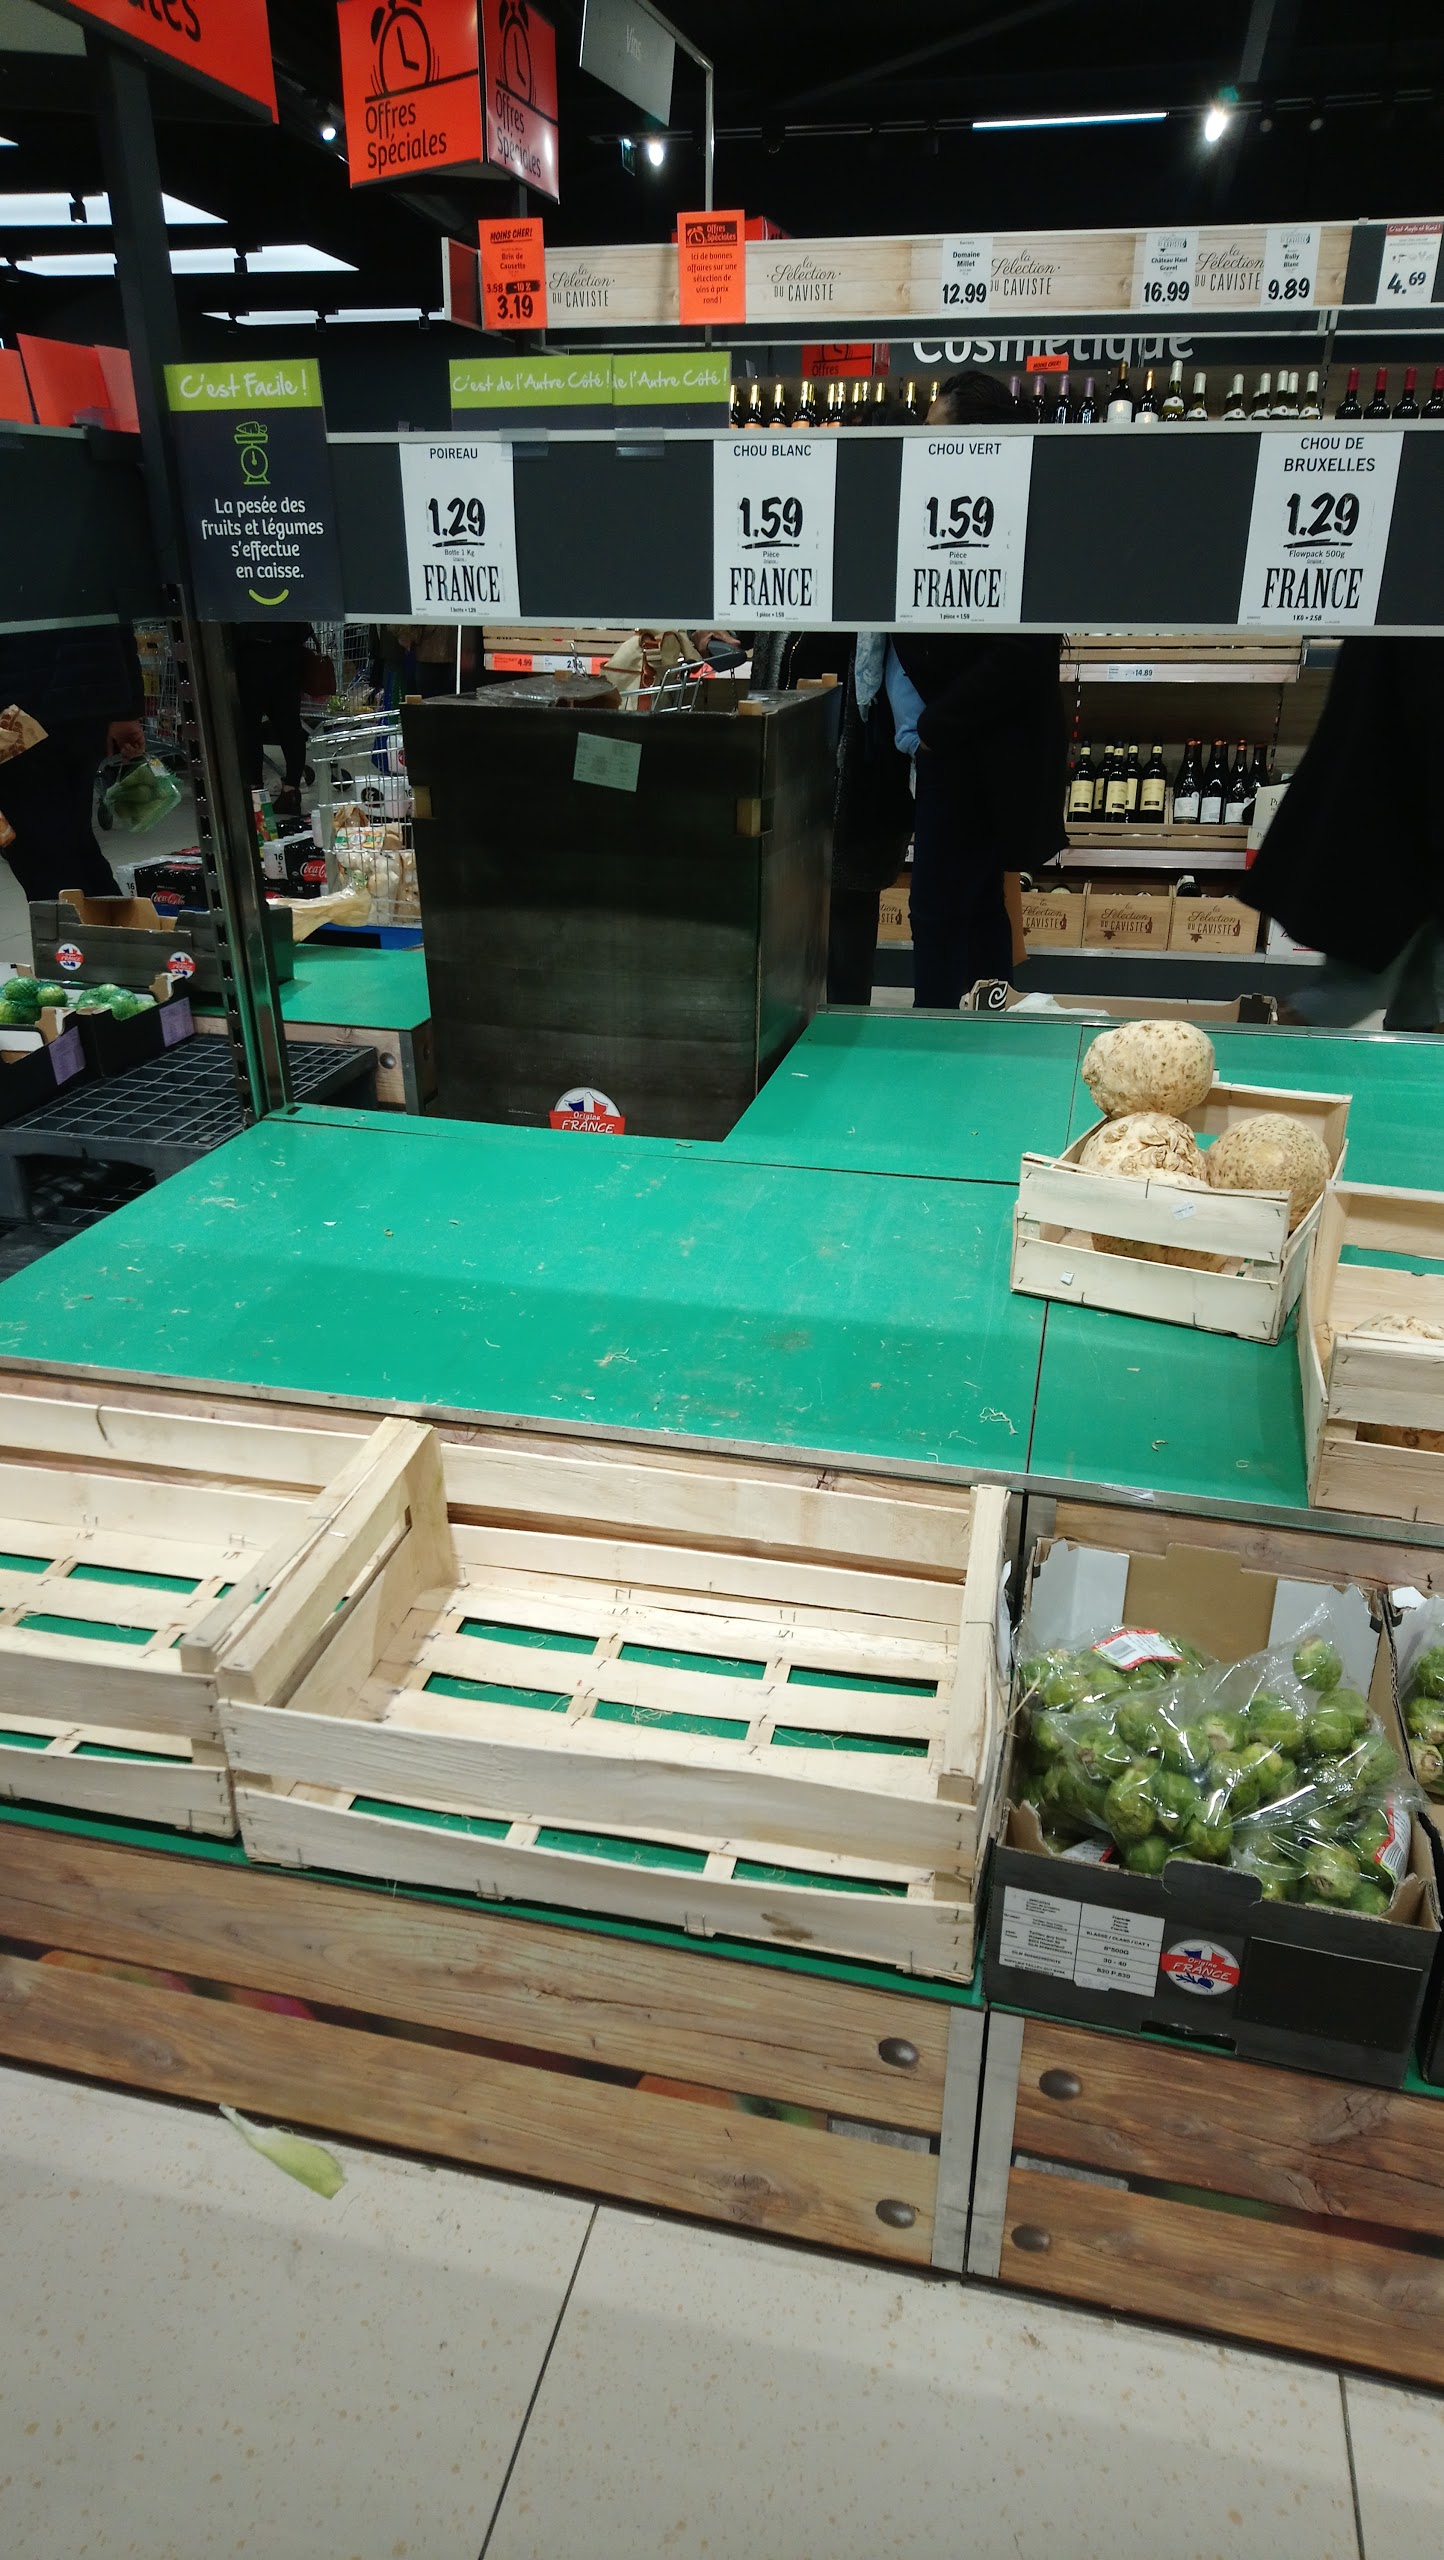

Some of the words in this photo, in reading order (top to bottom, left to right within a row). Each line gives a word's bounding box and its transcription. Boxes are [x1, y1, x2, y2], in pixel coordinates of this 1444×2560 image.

[365, 102, 416, 139] Offres
[495, 92, 525, 133] Offres
[367, 129, 447, 175] Spéciales
[497, 127, 541, 177] Spéciales
[490, 230, 511, 241] MOINS
[512, 228, 533, 238] CHER!
[706, 224, 726, 234] Offres
[707, 232, 736, 242] Spéciales
[516, 252, 523, 260] de
[1198, 252, 1264, 271] Sélection
[771, 264, 836, 283] Sélection
[991, 258, 1055, 277] Sélection
[549, 272, 612, 290] Sélection
[693, 274, 722, 282] sélection
[1004, 278, 1052, 296] CAVISTE
[1195, 274, 1206, 287] DU
[1210, 272, 1260, 291] CAVISTE
[716, 286, 729, 294] prix
[774, 286, 784, 298] DU
[788, 284, 834, 302] CAVISTE
[942, 282, 986, 304] 12.99
[1144, 281, 1190, 302] 16.99
[1268, 278, 1310, 300] 9.89
[497, 294, 534, 320] 3.19
[552, 292, 562, 304] DU
[566, 290, 608, 308] CAVISTE
[629, 371, 680, 389] l'Autre
[683, 369, 721, 387] Côté
[812, 364, 839, 377] Offres
[180, 373, 240, 398] C'est
[243, 370, 298, 397] Facile
[302, 369, 307, 396] !
[452, 376, 493, 392] C'est
[497, 376, 514, 391] de
[516, 372, 566, 391] l'Autre
[568, 370, 604, 389] Côté
[734, 445, 768, 456] CHOU
[772, 445, 812, 456] BLANC
[928, 443, 964, 455] CHOU
[969, 443, 1002, 454] VERT
[1300, 437, 1341, 450] CHOU
[1345, 437, 1364, 450] DE
[430, 448, 478, 459] POIREAU
[1283, 458, 1376, 472] BRUXELLES
[215, 498, 233, 514] La
[237, 496, 278, 518] pesée
[280, 496, 306, 514] des
[1287, 492, 1360, 537] 1.29
[428, 498, 486, 537] 1.29
[740, 496, 803, 539] 1.59
[926, 496, 994, 539] 1.59
[202, 519, 241, 540] fruits
[245, 520, 260, 536] et
[262, 518, 324, 540] légumes
[231, 540, 300, 561] s'effectue
[1289, 550, 1323, 558] Flowpack
[1326, 550, 1346, 559] 500g
[236, 565, 254, 579] en
[257, 562, 304, 579] caisse.
[423, 564, 500, 602] FRANCE
[730, 568, 812, 606] FRANCE
[912, 568, 1002, 608] FRANCE
[1261, 568, 1363, 609] FRANCE
[573, 1111, 600, 1121] Origine
[562, 1120, 615, 1133] FRANCE
[1173, 1962, 1232, 1980] FRANCE
[1188, 1957, 1217, 1968] Origine
